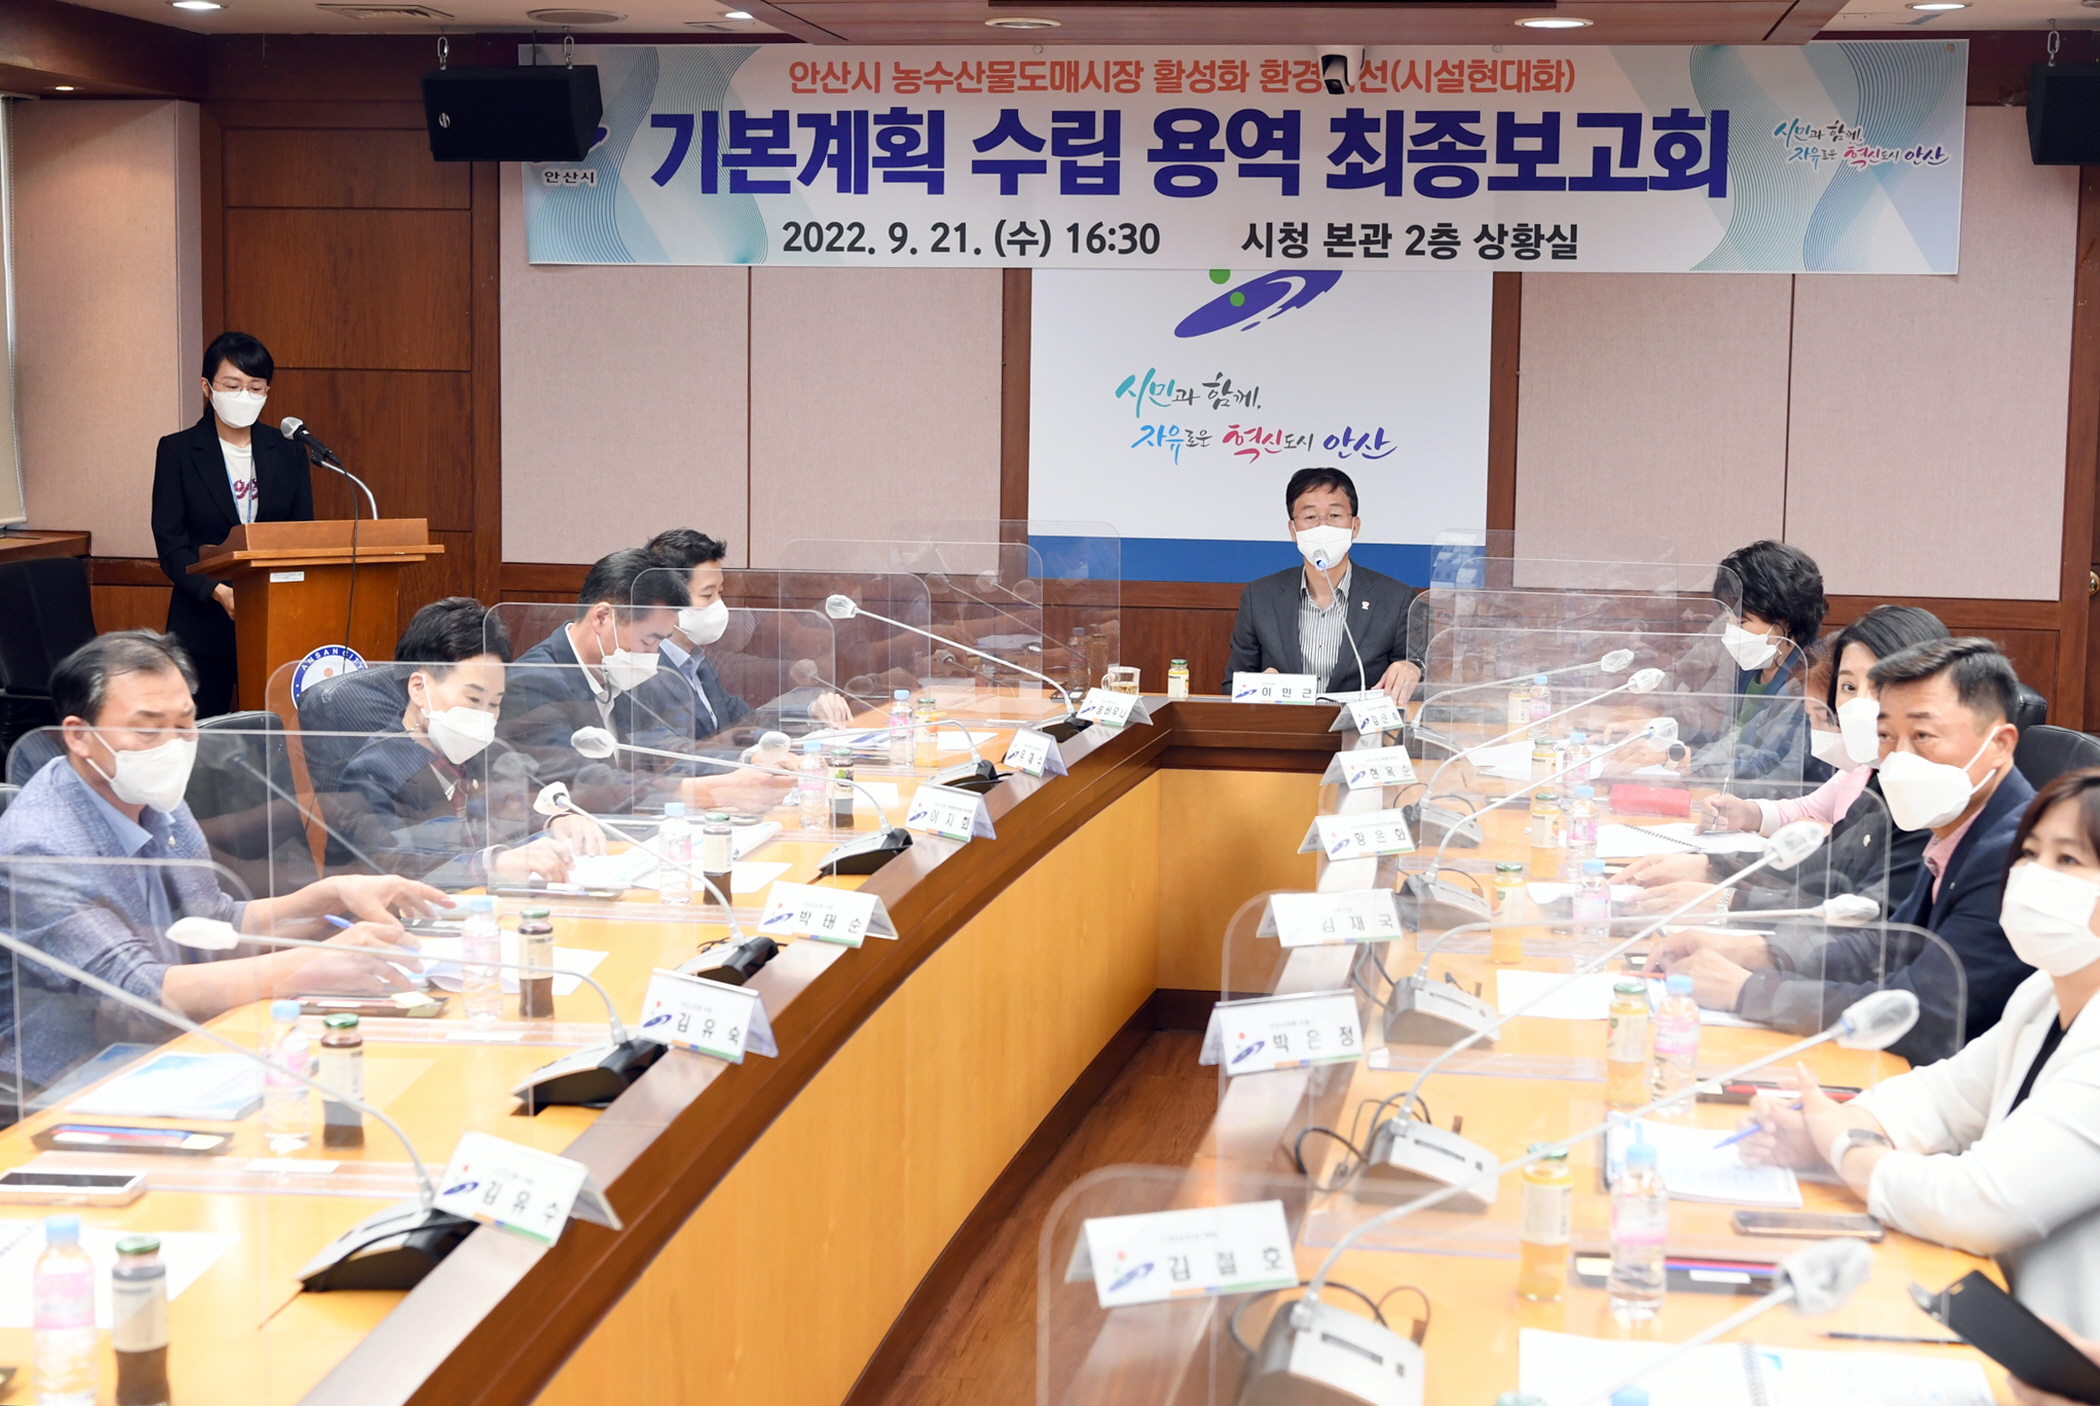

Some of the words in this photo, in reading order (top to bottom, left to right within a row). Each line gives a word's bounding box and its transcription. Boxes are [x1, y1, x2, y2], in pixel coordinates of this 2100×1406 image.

[789, 61, 881, 94] 안산시
[892, 60, 1145, 94] 농수산물도매시장
[1154, 59, 1250, 94] 활성화
[1259, 59, 1576, 94] 환경선(시설현대화)
[1773, 118, 1824, 147] 시민과
[652, 107, 945, 195] 기본계획
[972, 109, 1120, 196] 수립
[1149, 109, 1300, 198] 용역
[1328, 108, 1730, 199] 최종보고회
[1788, 147, 1838, 171] 자유로운
[1844, 146, 1899, 168] 혁신도시
[1904, 146, 1950, 165] 안산
[544, 172, 595, 184] 안산시
[783, 222, 876, 255] 2022.
[889, 222, 918, 255] 9.
[931, 222, 982, 256] 21.
[995, 220, 1051, 258] (수)
[1067, 222, 1160, 255] 16:30
[1242, 222, 1309, 259] 시청
[1324, 222, 1392, 259] 본관
[1406, 222, 1462, 260] 2층
[1474, 222, 1578, 261] 상황실
[1115, 367, 1200, 418] 시민과
[1131, 424, 1212, 465] 자유로운
[1222, 424, 1314, 463] 혁신도시
[1323, 426, 1398, 460] 안산
[302, 648, 338, 671] ANSAN
[342, 650, 365, 669] CITY
